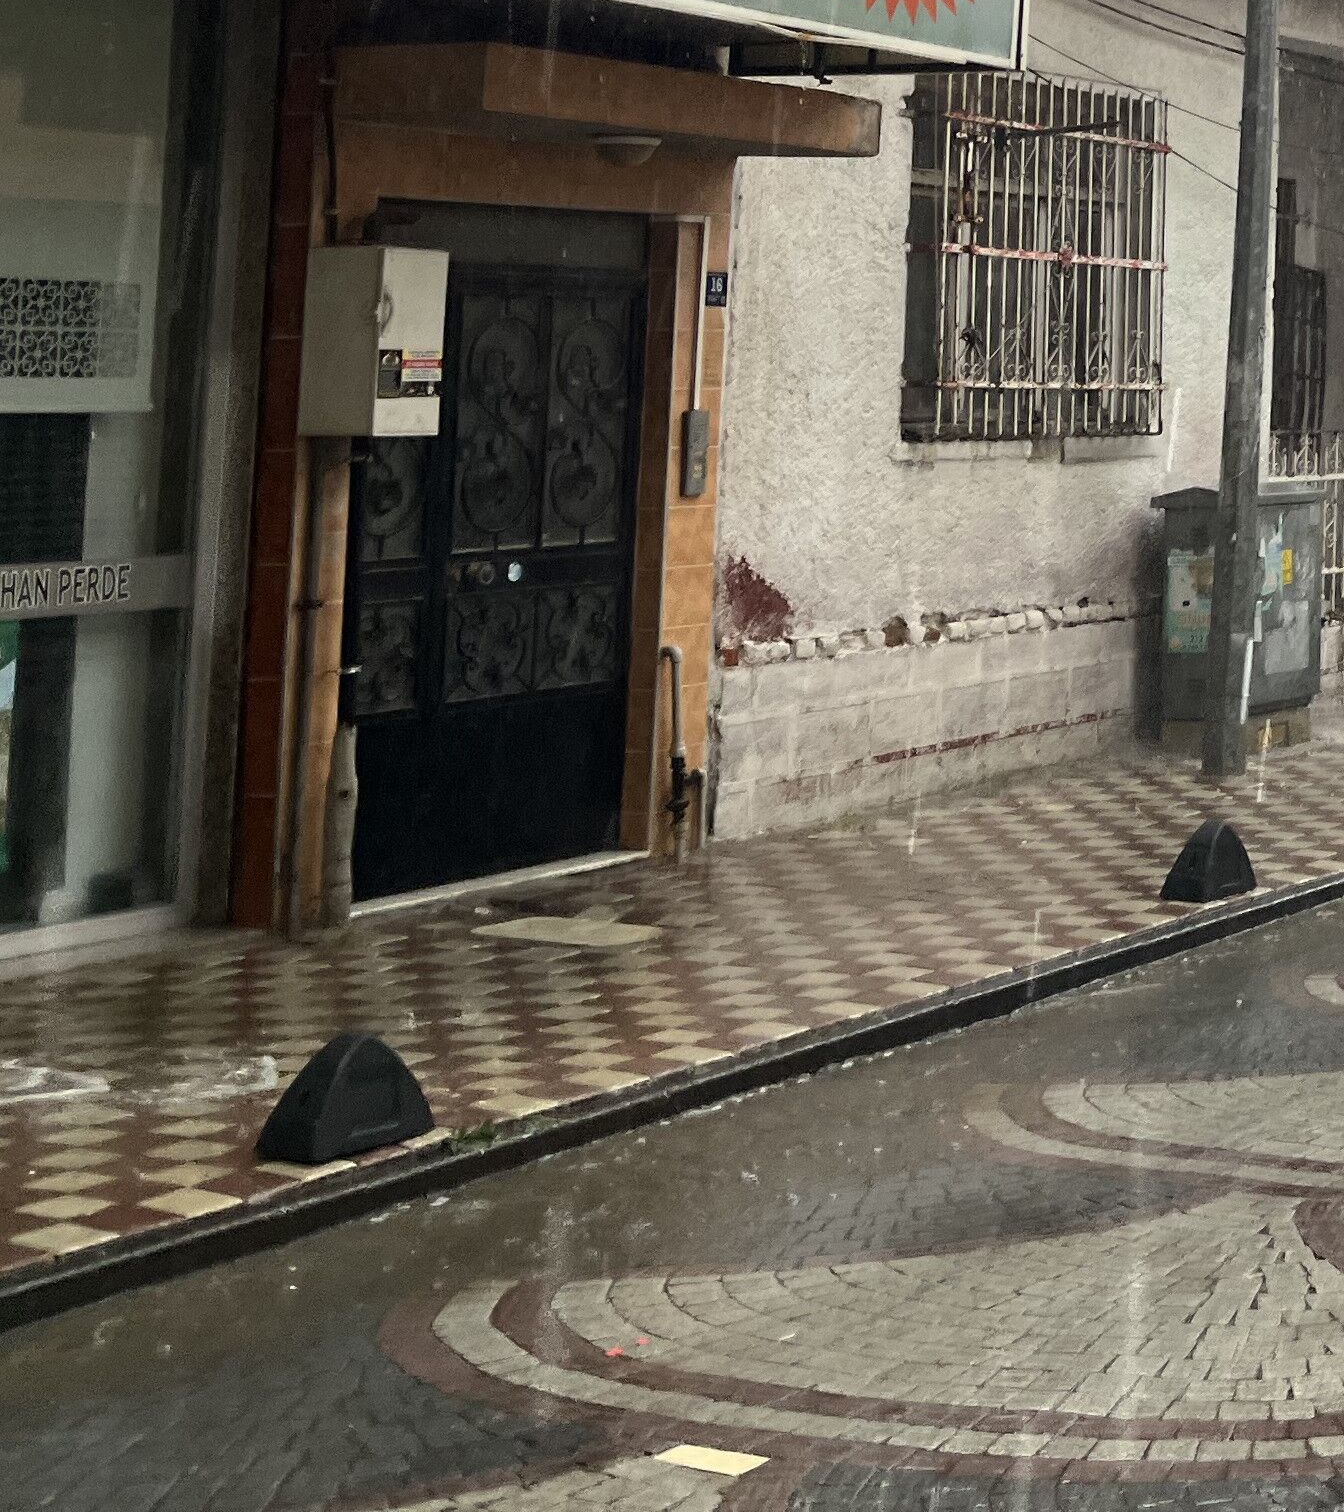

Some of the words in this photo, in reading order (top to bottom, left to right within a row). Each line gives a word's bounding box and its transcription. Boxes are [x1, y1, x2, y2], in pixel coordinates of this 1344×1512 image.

[711, 277, 723, 292] 16
[0, 571, 50, 609] HAN
[58, 565, 131, 606] PERDE
